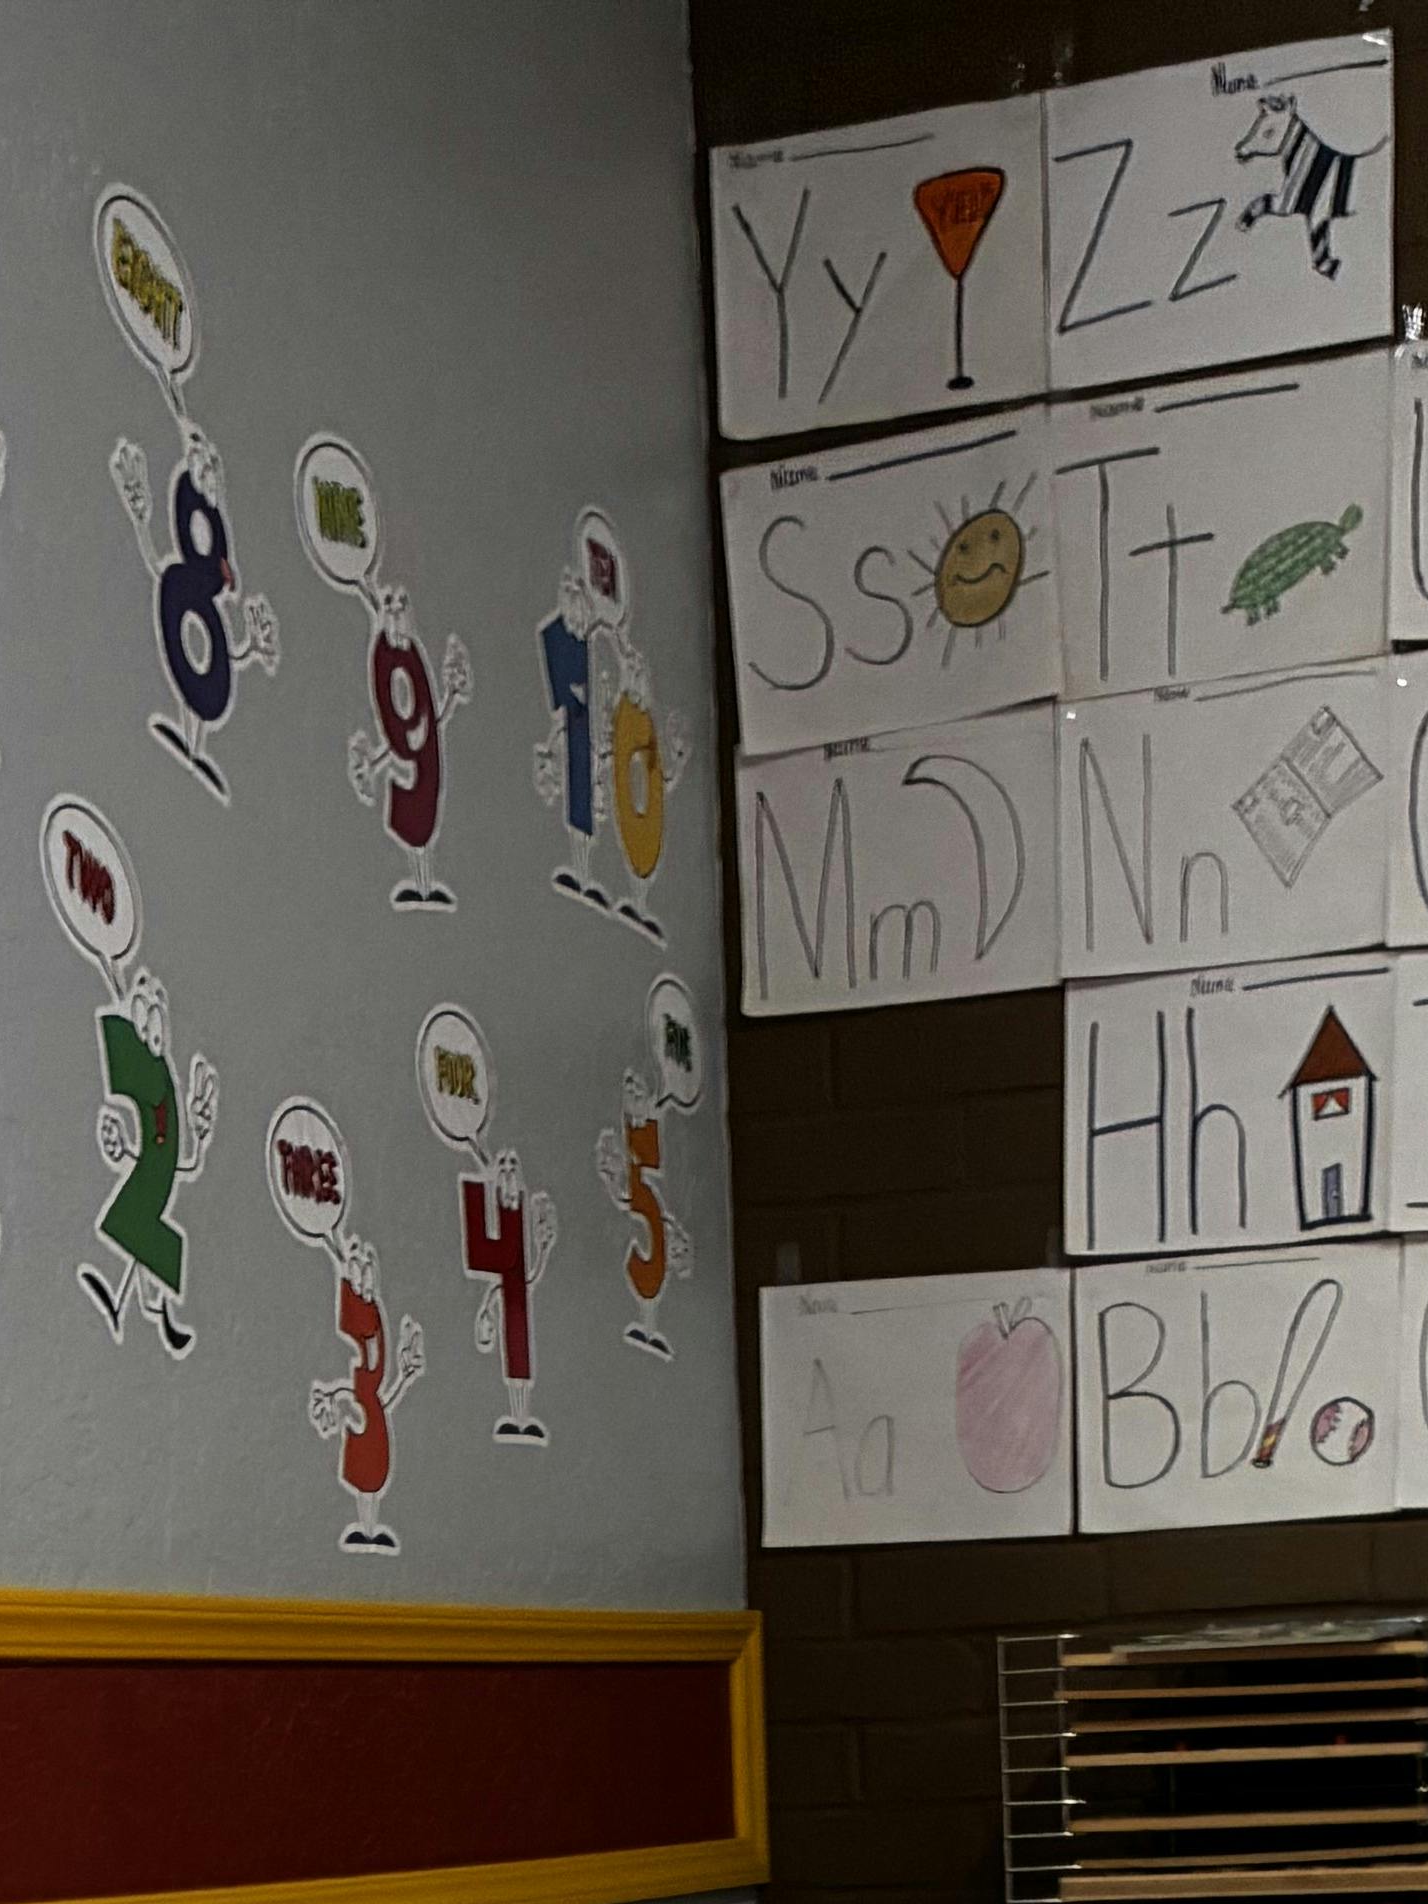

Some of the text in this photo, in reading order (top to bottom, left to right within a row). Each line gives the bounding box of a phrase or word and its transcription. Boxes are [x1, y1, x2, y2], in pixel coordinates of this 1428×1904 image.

[1211, 62, 1259, 97] Name
[731, 186, 888, 406] Yy
[1052, 136, 1239, 338] Zz
[157, 467, 234, 724] 8
[746, 514, 916, 693] Ss
[1055, 445, 1216, 683] Tt
[370, 627, 444, 850] 9
[537, 612, 666, 880] 10
[1079, 731, 1230, 953] Nn
[63, 828, 119, 928] TWO
[754, 776, 943, 1001] Mm
[99, 1012, 186, 1296] 2
[434, 1044, 482, 1107] FOUR
[1085, 1004, 1248, 1252] Hh
[459, 1178, 532, 1382] 4
[625, 1116, 669, 1302] 5
[337, 1276, 392, 1495] 3
[787, 1356, 897, 1503] Aa
[1097, 1290, 1264, 1491] Bb
